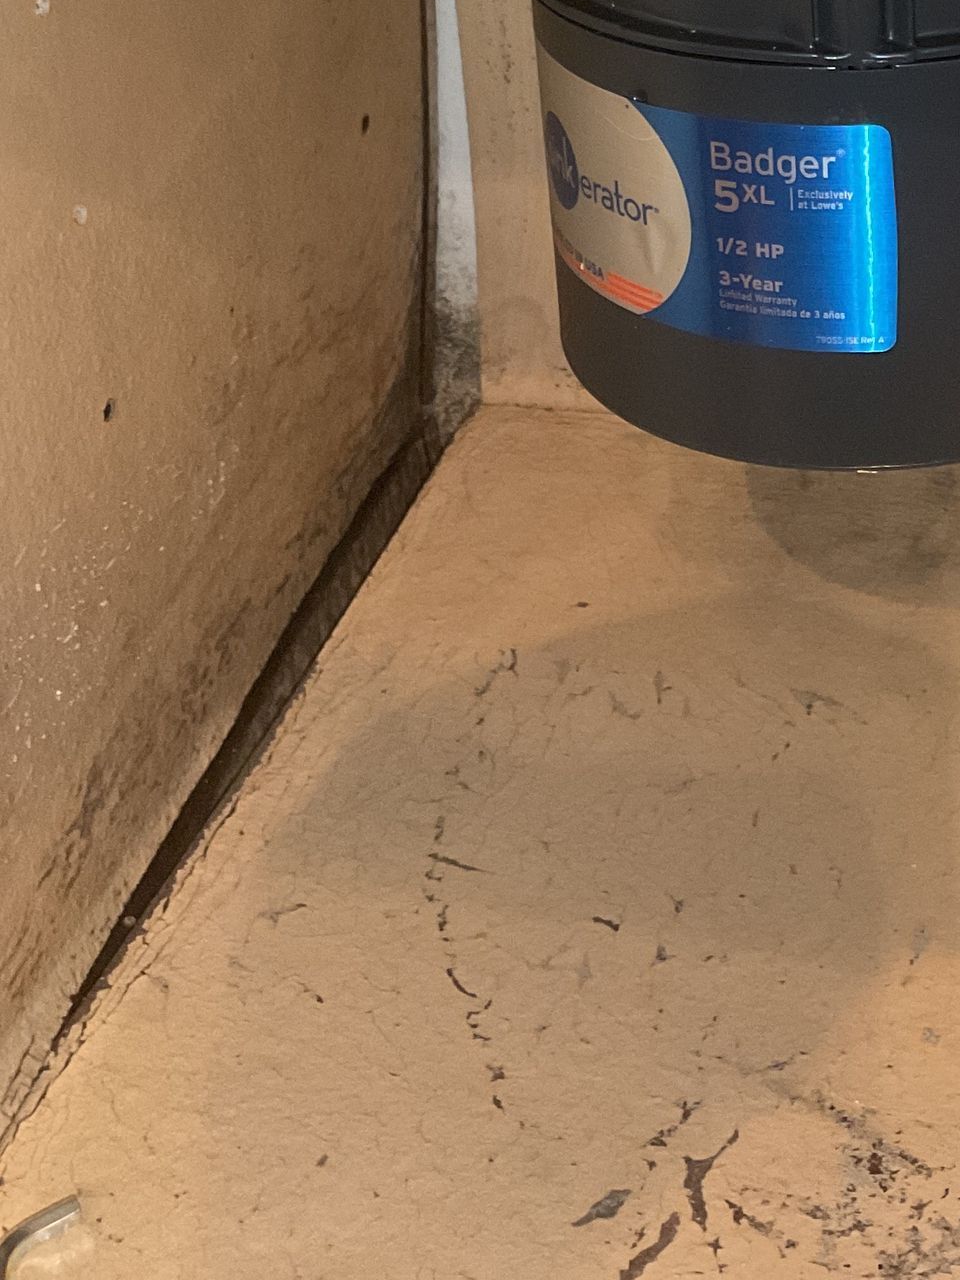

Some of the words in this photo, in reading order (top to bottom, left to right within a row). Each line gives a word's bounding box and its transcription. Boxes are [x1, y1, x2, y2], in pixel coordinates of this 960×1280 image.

[710, 141, 836, 184] Badger
[797, 190, 853, 201] Exclusively
[798, 201, 808, 209] at
[811, 202, 843, 210] Lowe's
[717, 238, 747, 255] 1/2
[756, 243, 784, 259] HP
[719, 271, 783, 293] 3-Year
